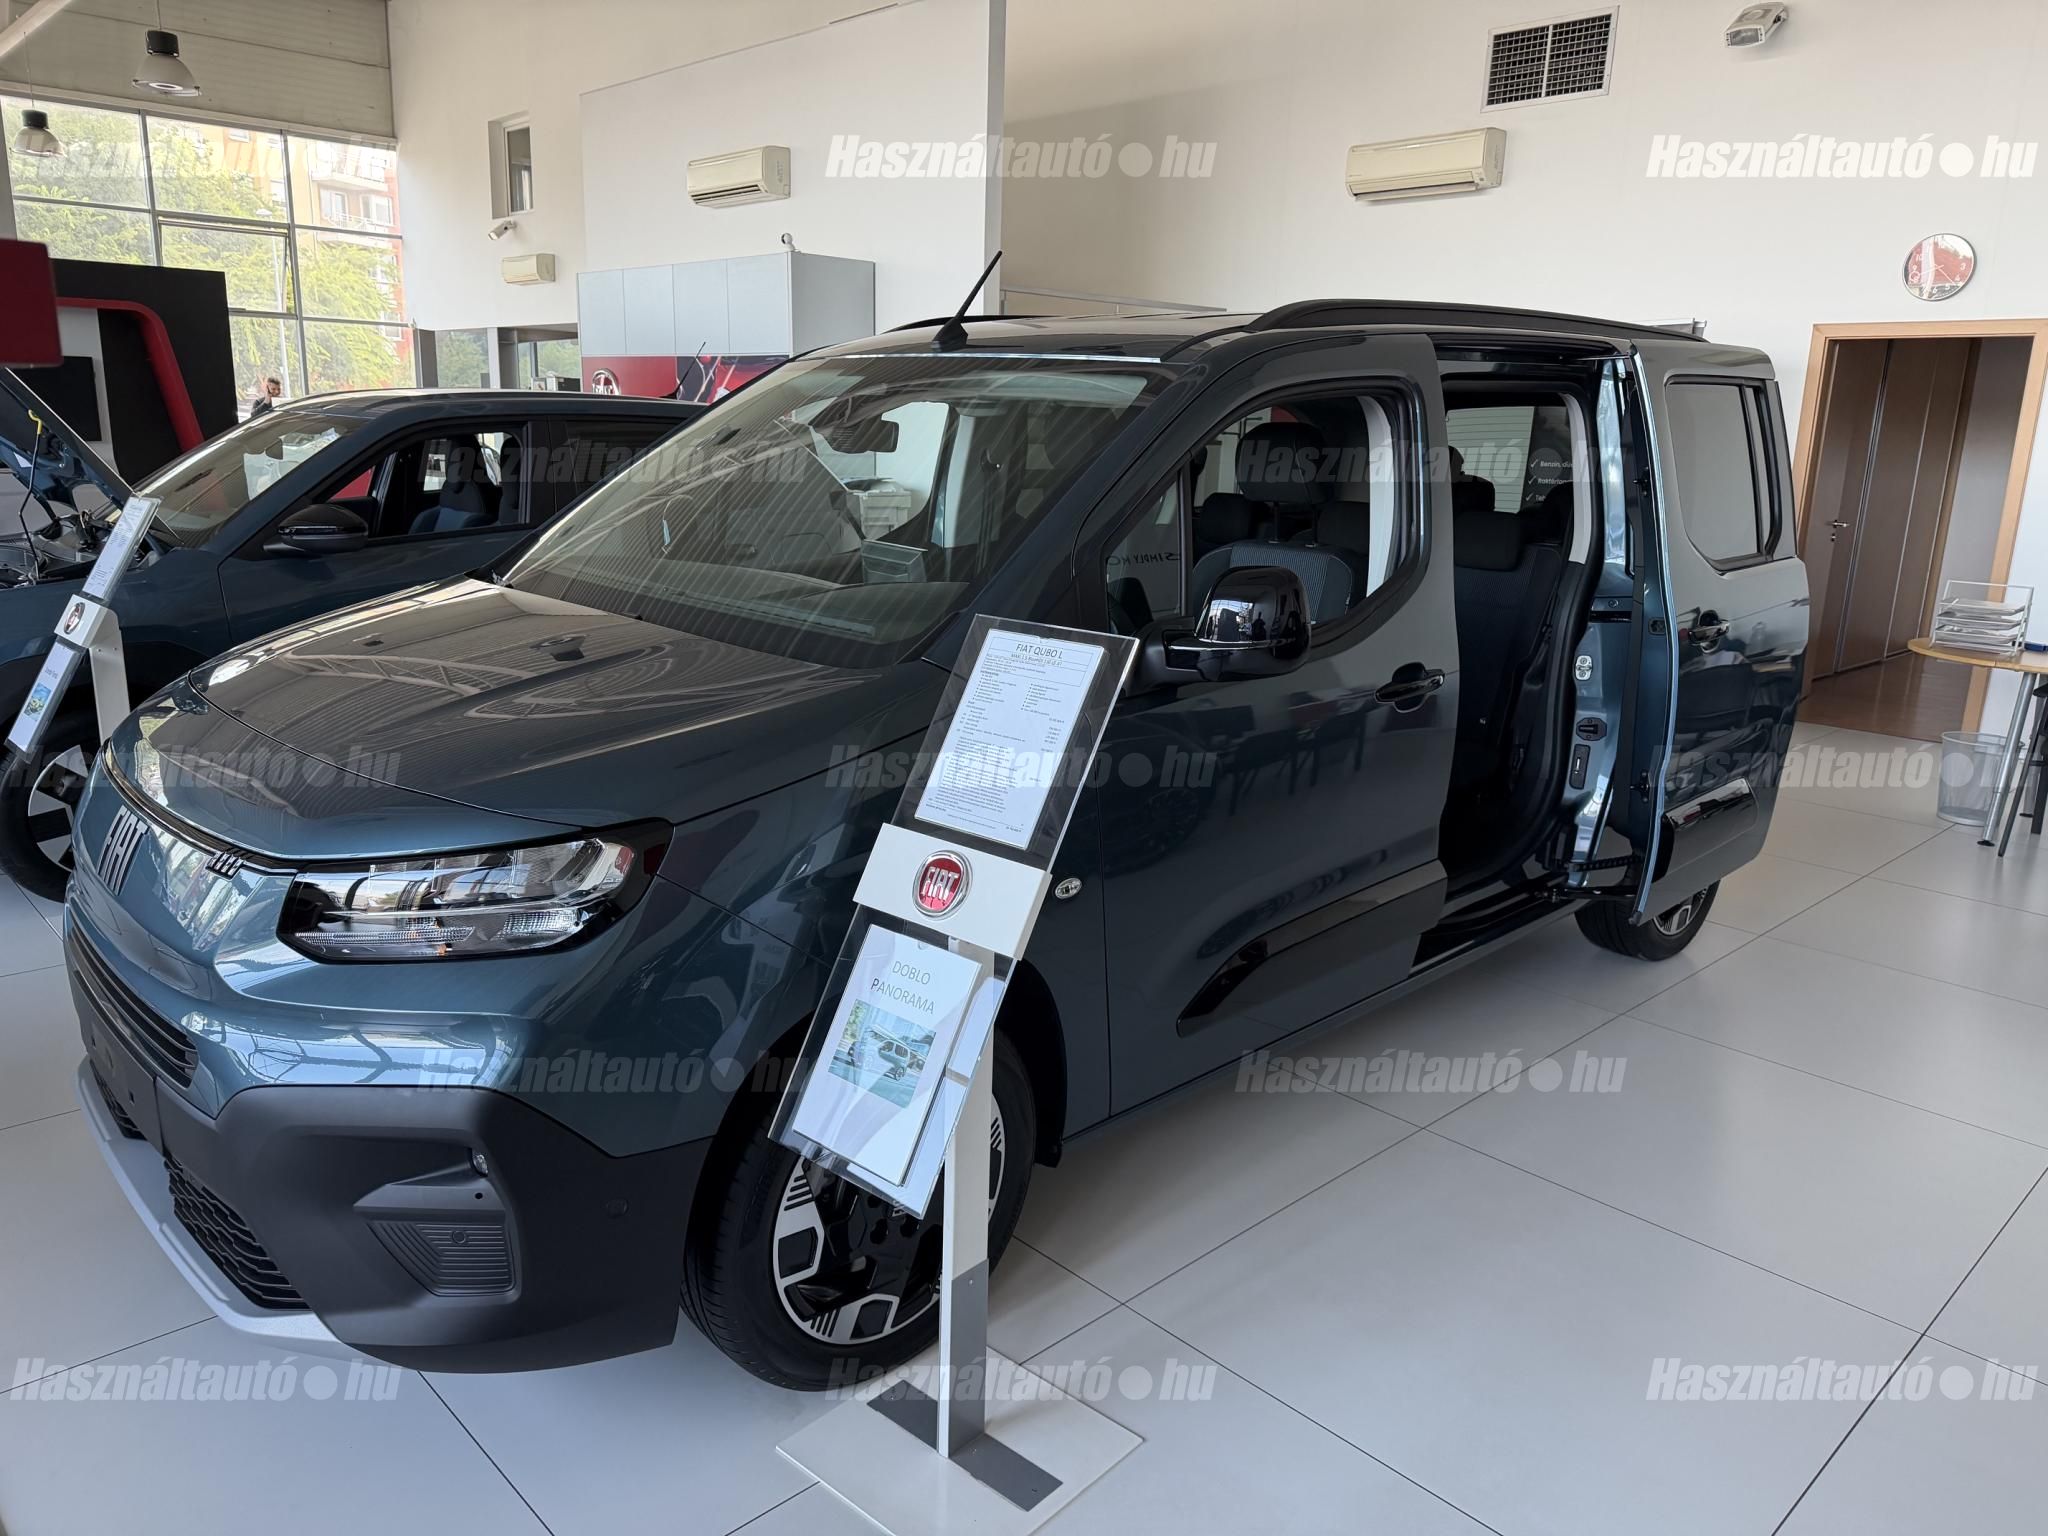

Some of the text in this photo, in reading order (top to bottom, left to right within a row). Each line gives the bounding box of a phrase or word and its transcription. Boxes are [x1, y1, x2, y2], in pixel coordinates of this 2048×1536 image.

[1016, 643, 1033, 653] FIAT
[1033, 646, 1057, 658] QUBO
[95, 804, 150, 897] FIAT
[920, 866, 961, 901] FIAT
[892, 960, 932, 985] DOBLO
[870, 977, 935, 1015] PANORAMA
